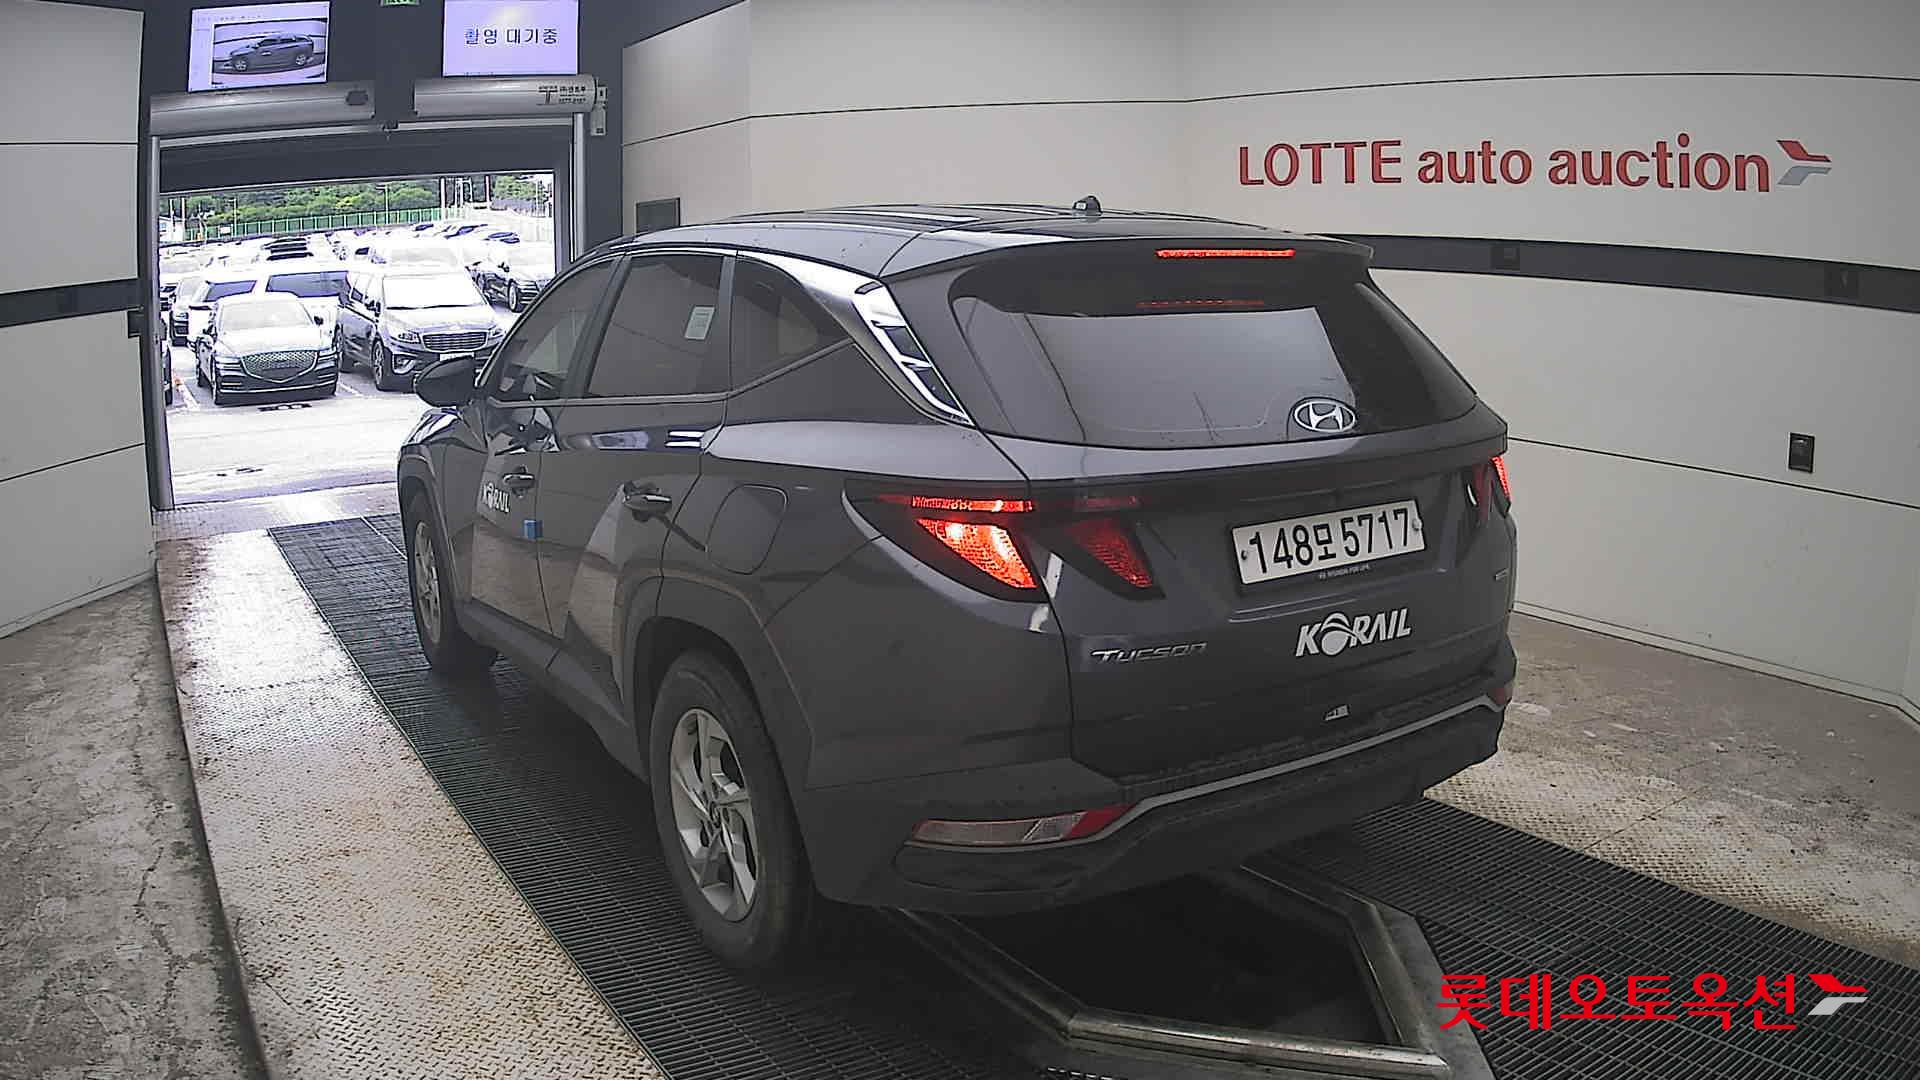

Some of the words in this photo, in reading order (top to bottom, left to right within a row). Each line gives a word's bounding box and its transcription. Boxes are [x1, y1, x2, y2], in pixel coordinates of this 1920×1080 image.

[506, 28, 558, 45] 대기중
[1239, 139, 1402, 186] LOTTE
[1417, 140, 1532, 185] auto
[1547, 132, 1770, 193] auction
[1249, 507, 1408, 573] 148모5717
[1295, 607, 1412, 657] KORAIL
